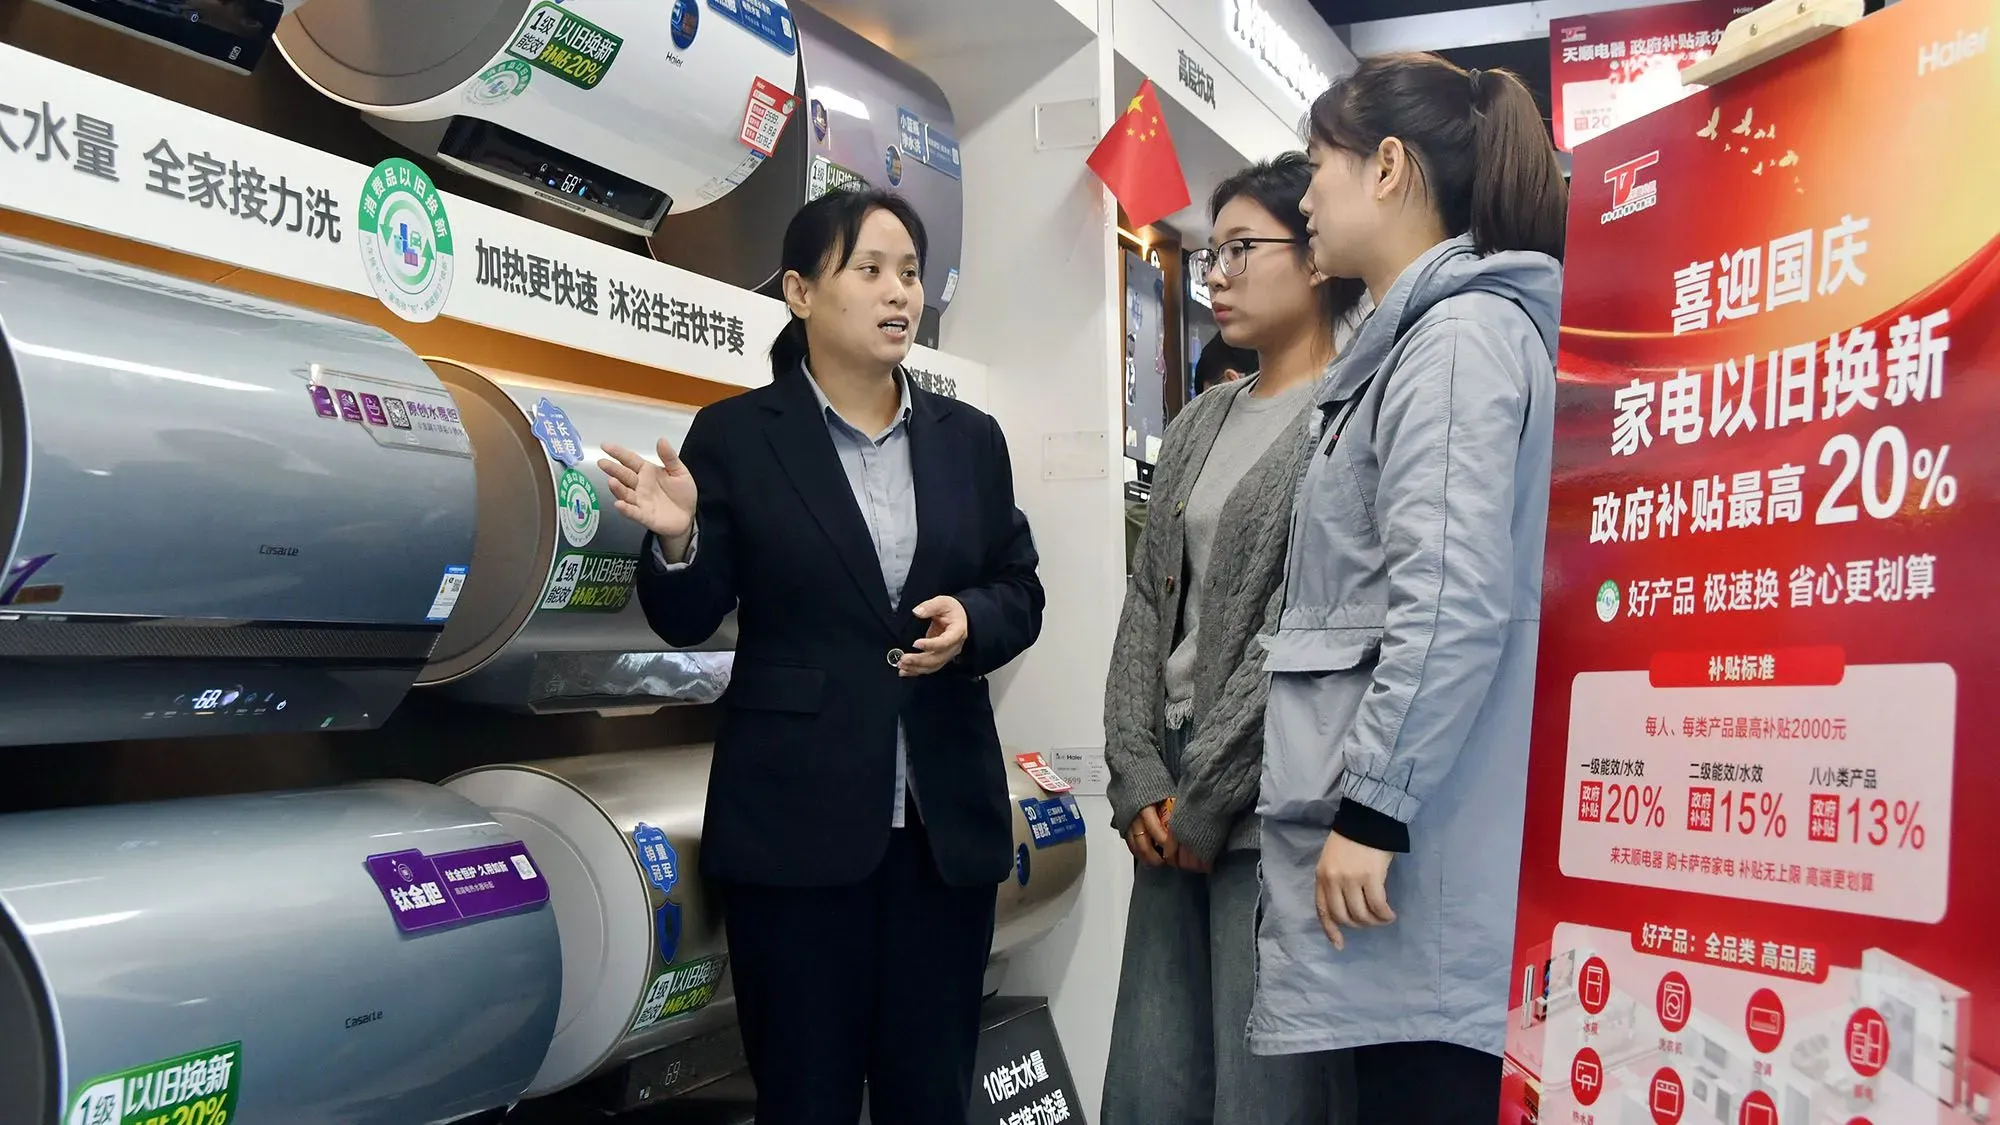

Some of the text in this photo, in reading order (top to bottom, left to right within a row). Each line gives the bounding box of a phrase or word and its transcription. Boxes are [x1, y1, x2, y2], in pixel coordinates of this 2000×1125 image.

[530, 11, 618, 63] 1级 以旧换新
[517, 32, 545, 55] 能效
[540, 44, 602, 85] 补贴20%
[665, 51, 684, 68] Haier
[1563, 42, 1626, 63] 天顺电器
[1917, 26, 1991, 77] Haier
[1178, 49, 1216, 110] 高层抗风
[143, 138, 342, 243] 全家接力洗
[363, 166, 448, 238] 消费品以旧换新
[1670, 214, 1870, 336] 喜迎国庆
[475, 237, 599, 316] 加热更快速
[608, 278, 745, 356] 沐浴生活快节奏
[1611, 308, 1950, 457] 家电以旧换新
[544, 420, 570, 436] 店长
[551, 438, 577, 455] 推荐
[1589, 425, 1958, 545] 政府补贴最高 20%
[259, 544, 299, 557] Casarte
[556, 556, 638, 584] 1级 以旧换新
[547, 585, 628, 607] 能效 补贴20%
[1627, 576, 1695, 617] 好产品
[1703, 567, 1779, 613] 极速换
[1788, 553, 1937, 608] 省心更划算
[1708, 654, 1776, 682] 补贴标准
[1645, 716, 1847, 740] 每人、每类产品最高补贴2000元
[1580, 758, 1645, 777] 一级能效/水效
[1689, 762, 1764, 783] 二级能效/水效
[1809, 767, 1877, 789] 八小类产品
[1582, 785, 1601, 800] 政府
[1605, 783, 1665, 828] 20%
[1690, 792, 1712, 809] 政府
[1581, 803, 1599, 818] 补贴
[1689, 810, 1711, 827] 补贴
[1720, 790, 1787, 838] 15%
[1812, 800, 1837, 818] 政府
[1847, 797, 1925, 849] 13%
[1811, 819, 1836, 838] 补贴
[1610, 847, 1875, 892] 来天顺电器 购卡萨帝家电 补贴无上限 高端更划算
[390, 881, 446, 912] 钛金胆
[1761, 941, 1816, 976] 高品质
[648, 980, 669, 1003] 1级
[344, 1009, 384, 1030] Casarte
[81, 1051, 234, 1125] 1级 以旧换新
[983, 1049, 1049, 1104] 10倍大水量
